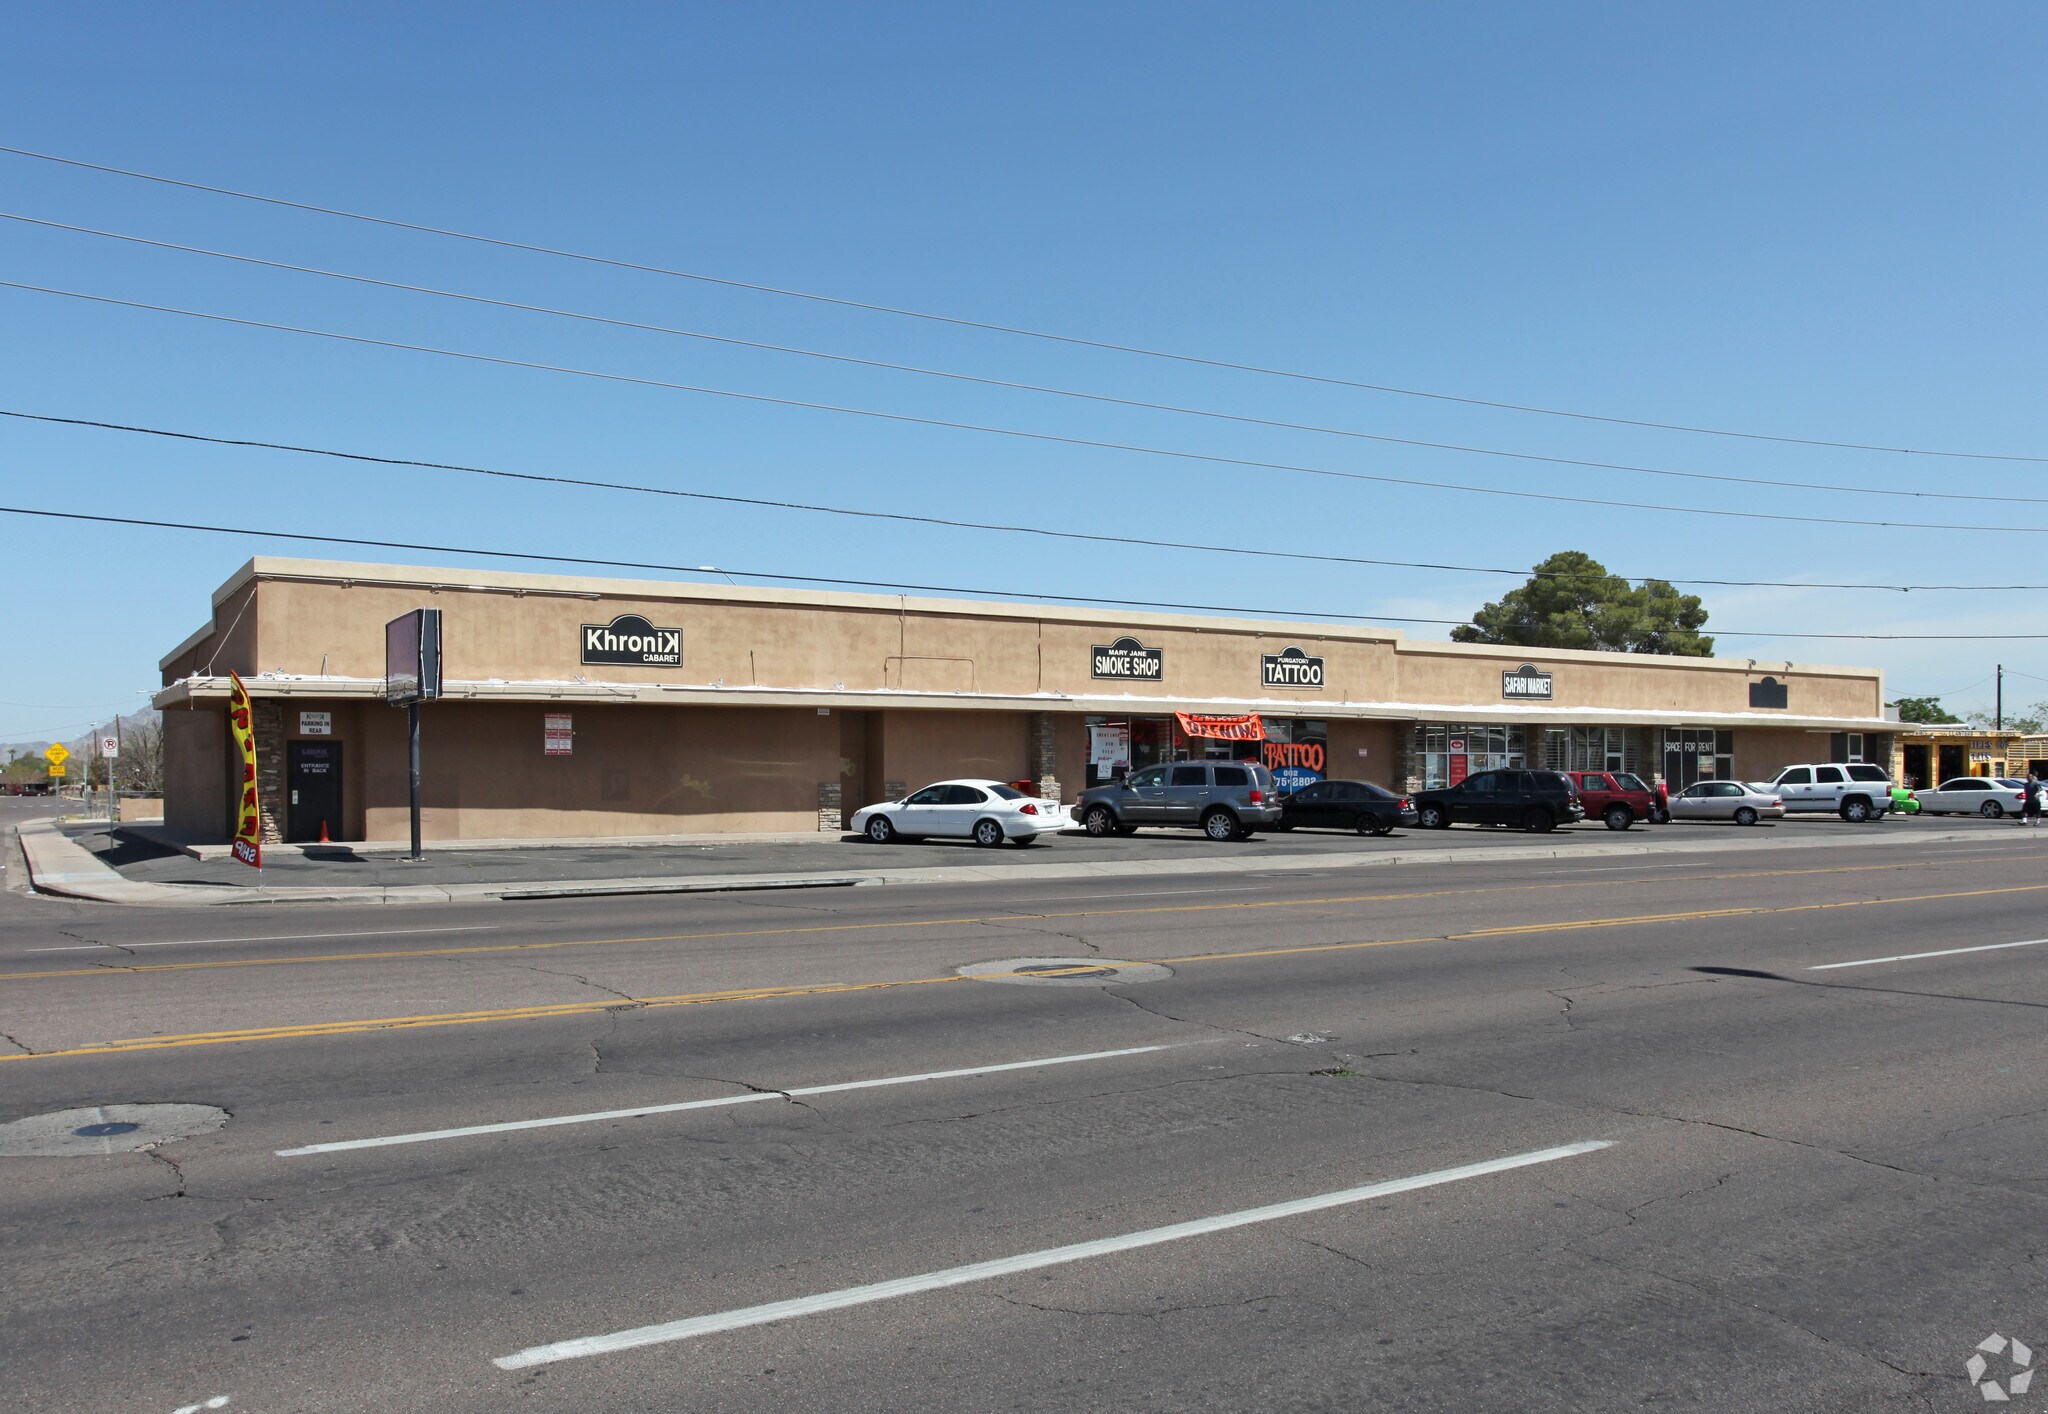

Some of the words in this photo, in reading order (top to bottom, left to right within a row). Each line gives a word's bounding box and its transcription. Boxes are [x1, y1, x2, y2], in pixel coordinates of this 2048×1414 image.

[643, 654, 679, 663] CABARET
[1095, 656, 1131, 675] SMOKE
[1133, 657, 1159, 676] SHOP
[1265, 663, 1321, 684] TATTOO
[1505, 676, 1527, 694] SAFARI
[1527, 677, 1551, 695] MARKET
[1665, 741, 1681, 752] SPACE
[1684, 741, 1696, 752] FOR
[1698, 741, 1714, 752] RENT
[1263, 743, 1325, 771] TATTOO
